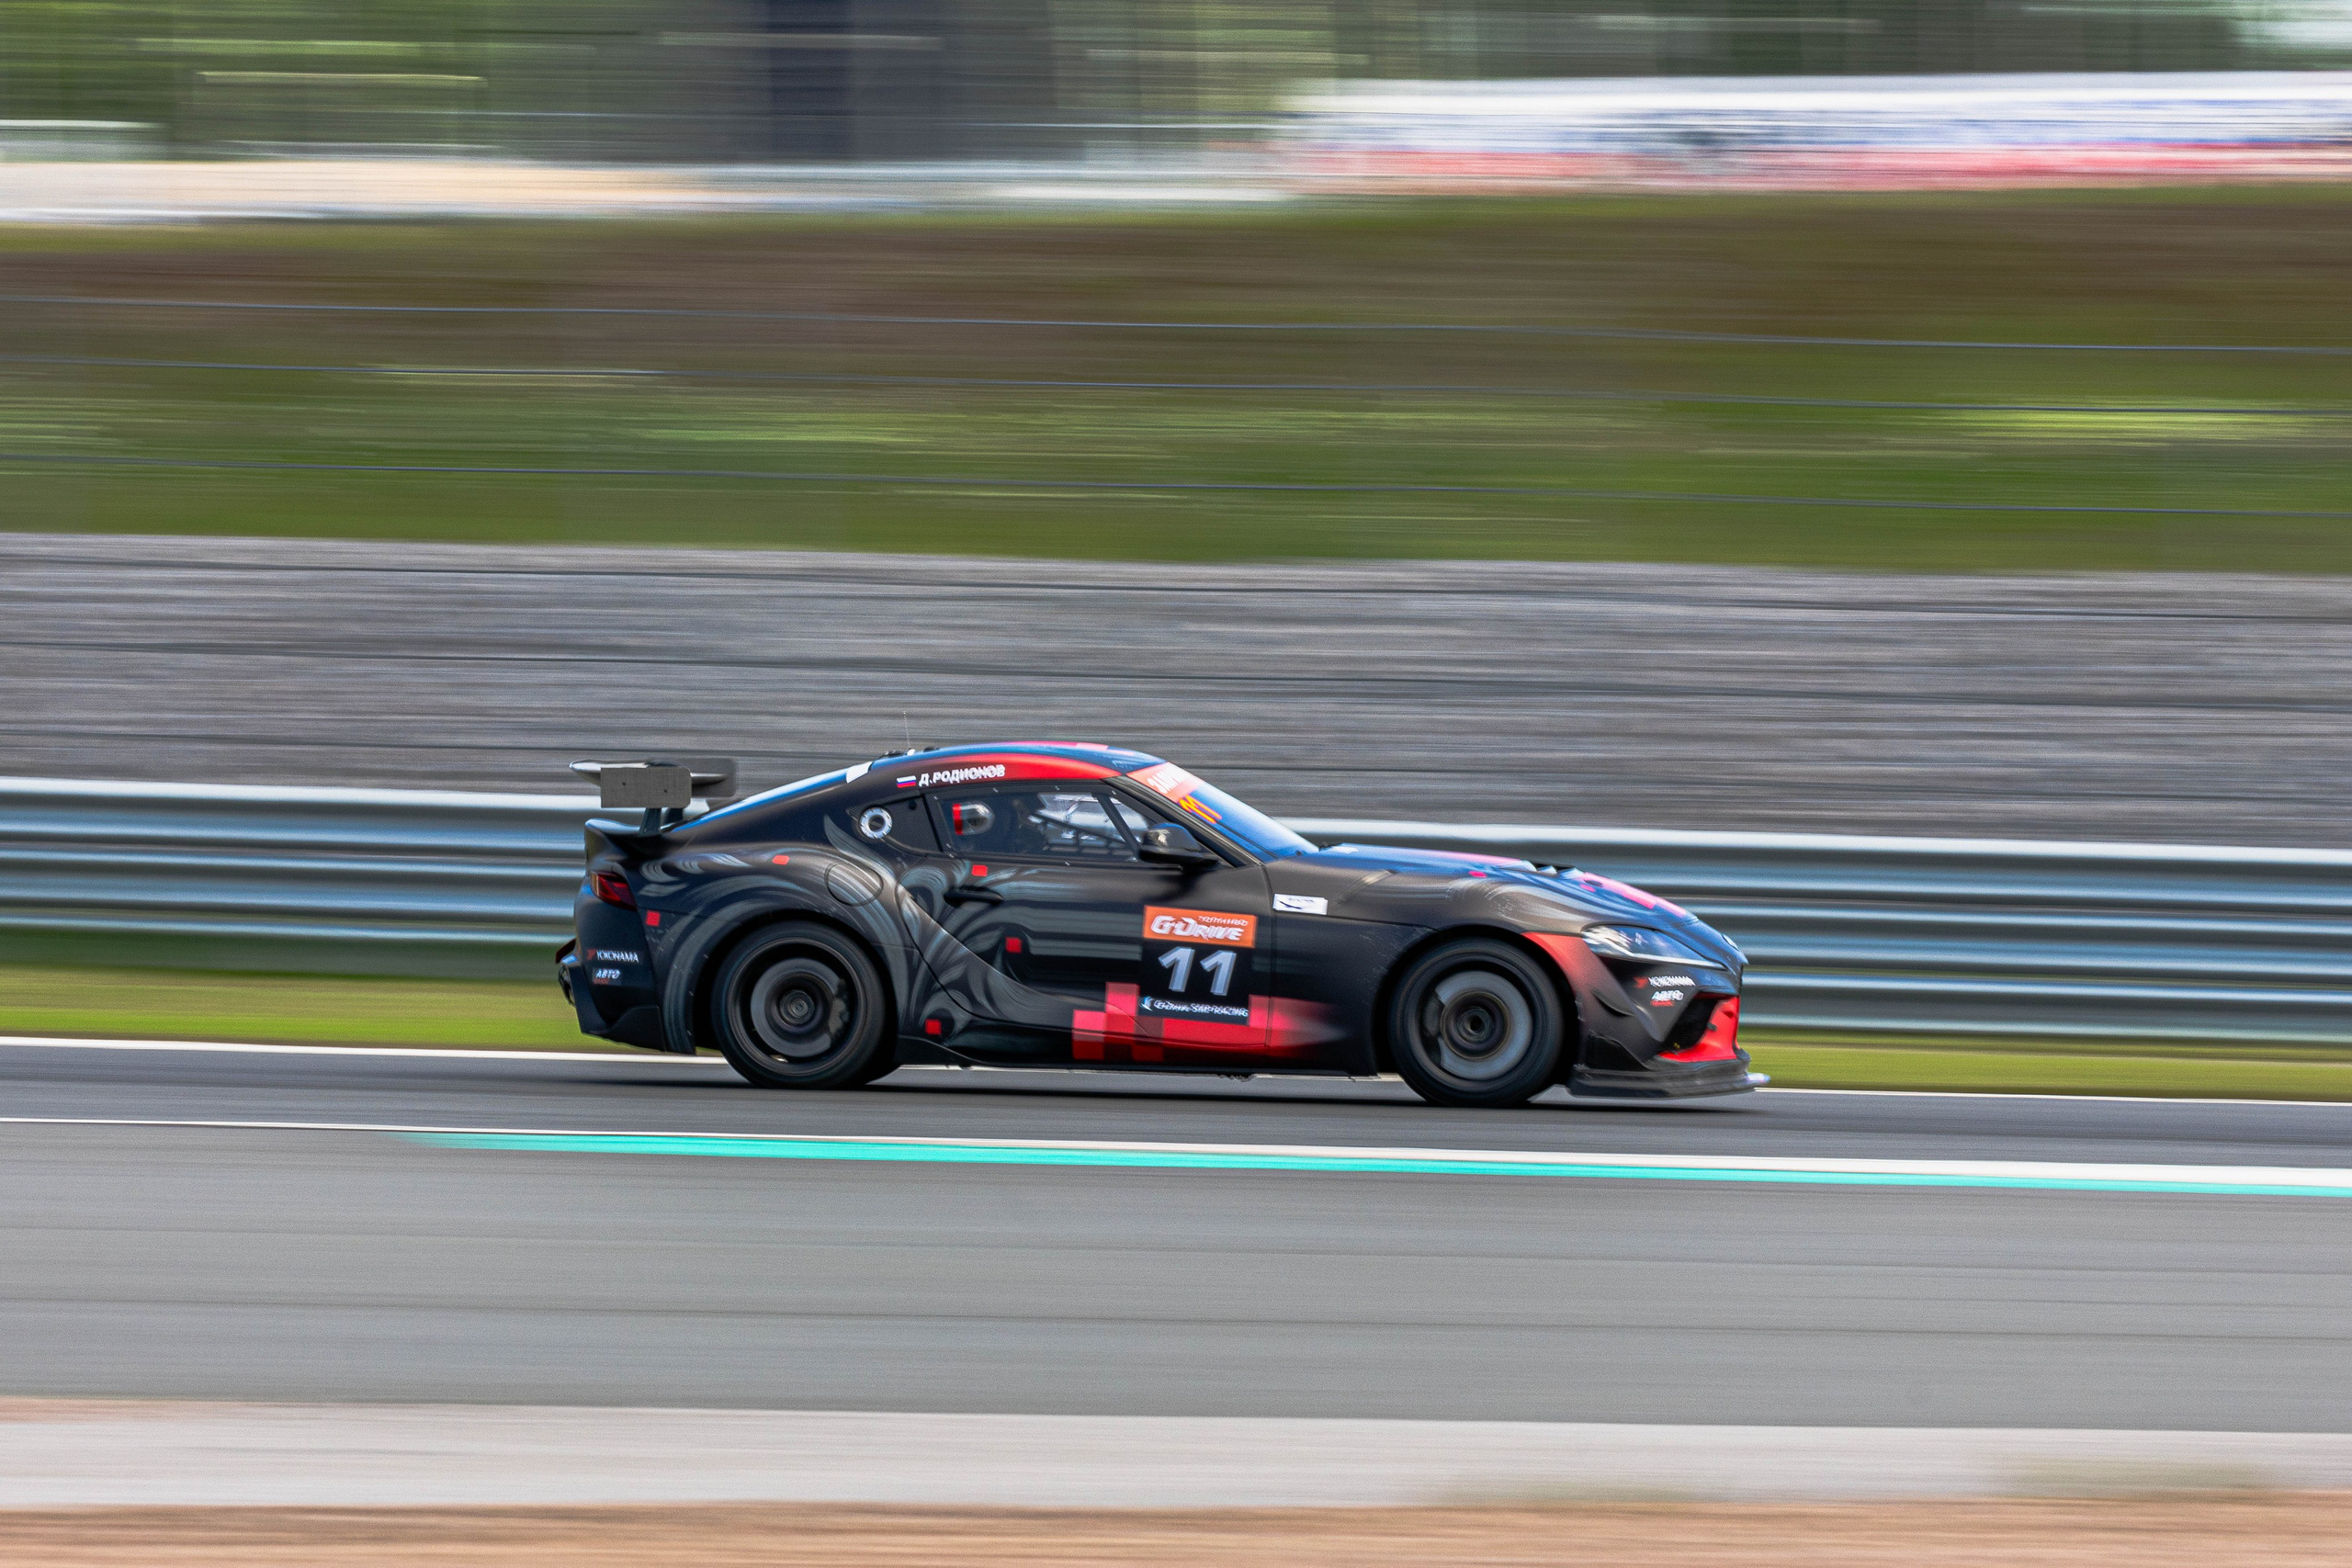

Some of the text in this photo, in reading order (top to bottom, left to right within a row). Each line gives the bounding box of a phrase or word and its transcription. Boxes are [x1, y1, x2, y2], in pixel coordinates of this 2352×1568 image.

[919, 764, 1005, 787] Д.РОДИОНОВ
[1150, 915, 1244, 941] G-DRIVE
[596, 950, 639, 963] YOKOHAMA
[1159, 946, 1237, 996] 11
[1648, 976, 1696, 987] YOKOHAMA
